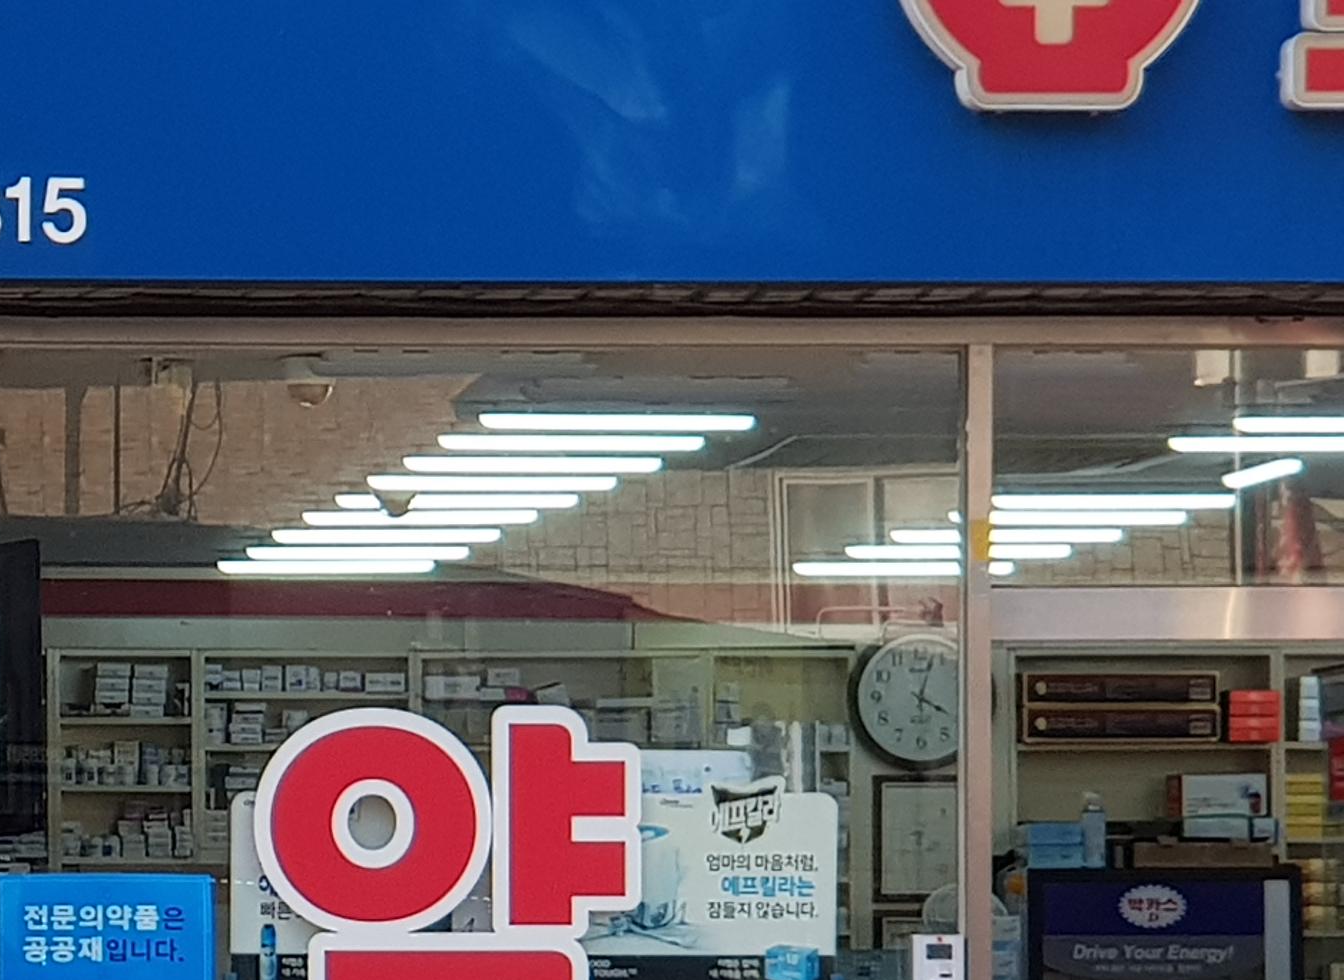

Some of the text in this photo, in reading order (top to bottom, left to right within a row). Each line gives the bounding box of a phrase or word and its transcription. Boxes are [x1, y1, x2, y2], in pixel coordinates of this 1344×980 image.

[706, 854, 751, 872] 엄마의
[721, 875, 816, 897] 에프킬라는
[24, 905, 185, 931] 전문의약품은
[708, 901, 751, 919] 잠들지
[23, 936, 184, 963] 공공재입니다.
[1072, 944, 1234, 964] Drive Your Energy!
